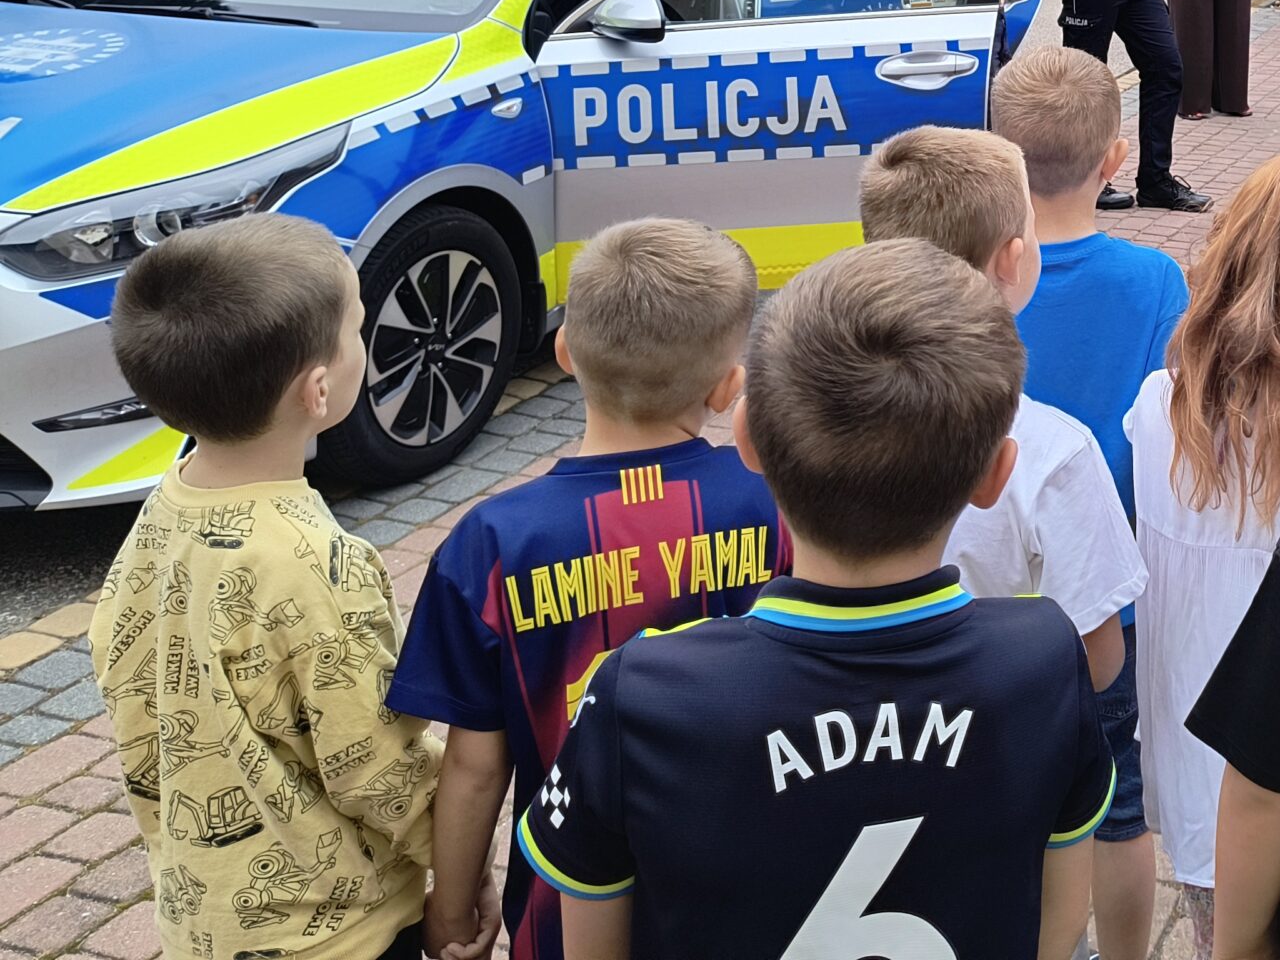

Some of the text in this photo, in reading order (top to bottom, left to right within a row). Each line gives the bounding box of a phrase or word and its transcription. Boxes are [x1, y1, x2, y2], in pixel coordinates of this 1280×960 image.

[573, 75, 847, 146] POLICJA
[505, 526, 771, 633] LAMINE YAMAL
[163, 634, 184, 695] MAKE IT
[317, 736, 373, 769] AWESO
[323, 751, 377, 781] MAKE
[766, 702, 974, 794] ADAM
[301, 876, 349, 937] AWOME
[780, 816, 958, 960] 6
[325, 912, 346, 932] IT
